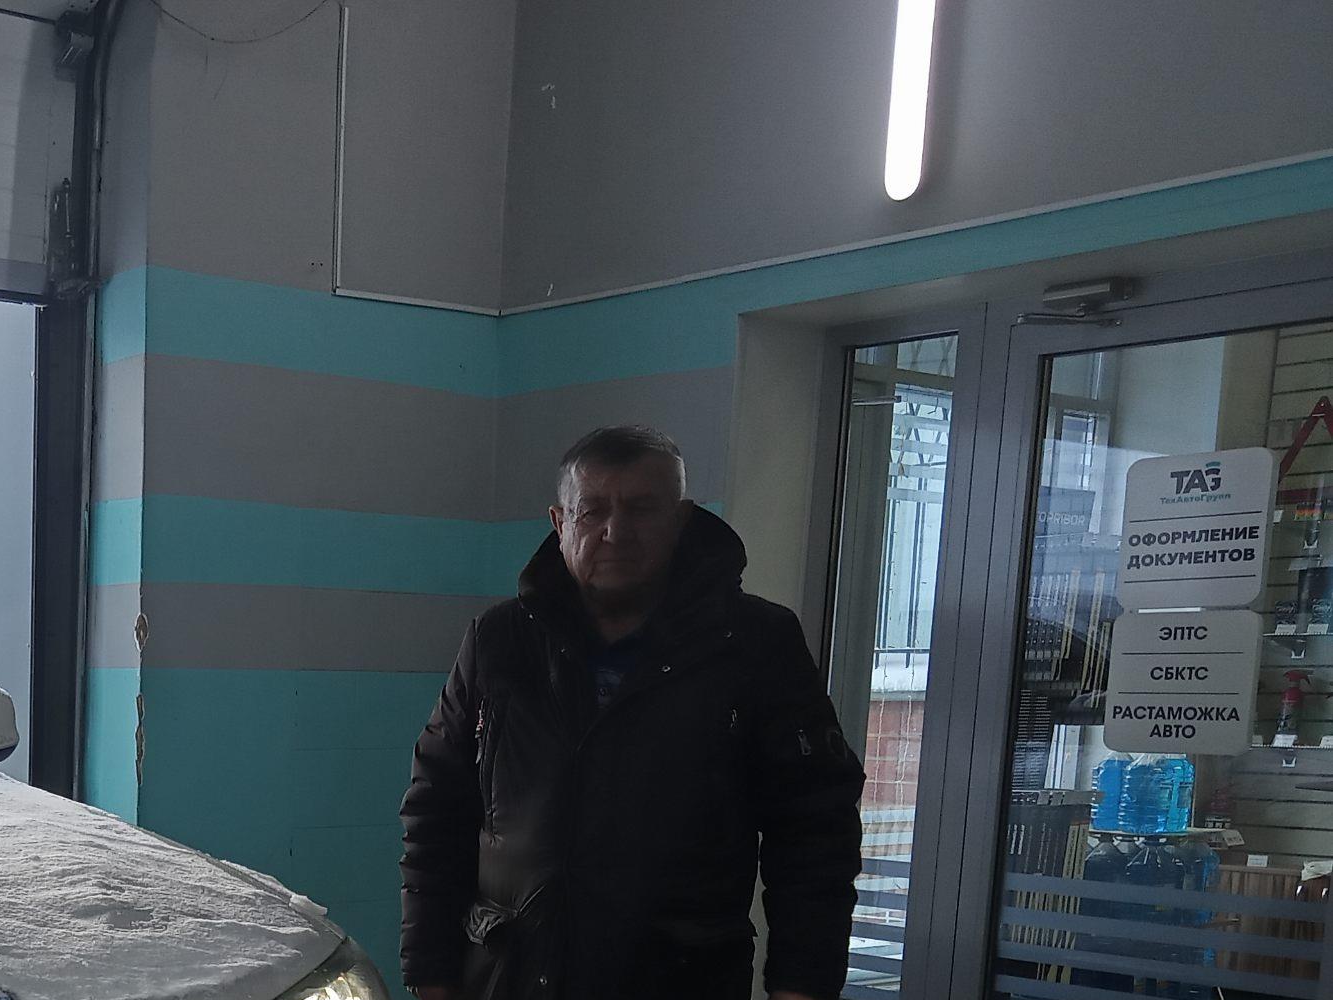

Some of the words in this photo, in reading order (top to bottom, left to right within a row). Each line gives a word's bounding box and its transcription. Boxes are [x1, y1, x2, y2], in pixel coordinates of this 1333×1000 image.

[1128, 526, 1259, 546] ОФОРМЛЕНИЕ
[1126, 548, 1255, 569] ДОКУМЕНТОВ
[1158, 626, 1208, 641] ЭПТС
[1150, 667, 1209, 681] СБКТС
[1112, 706, 1240, 722] РАСТАМОЖКА
[1149, 724, 1196, 739] АВТО
